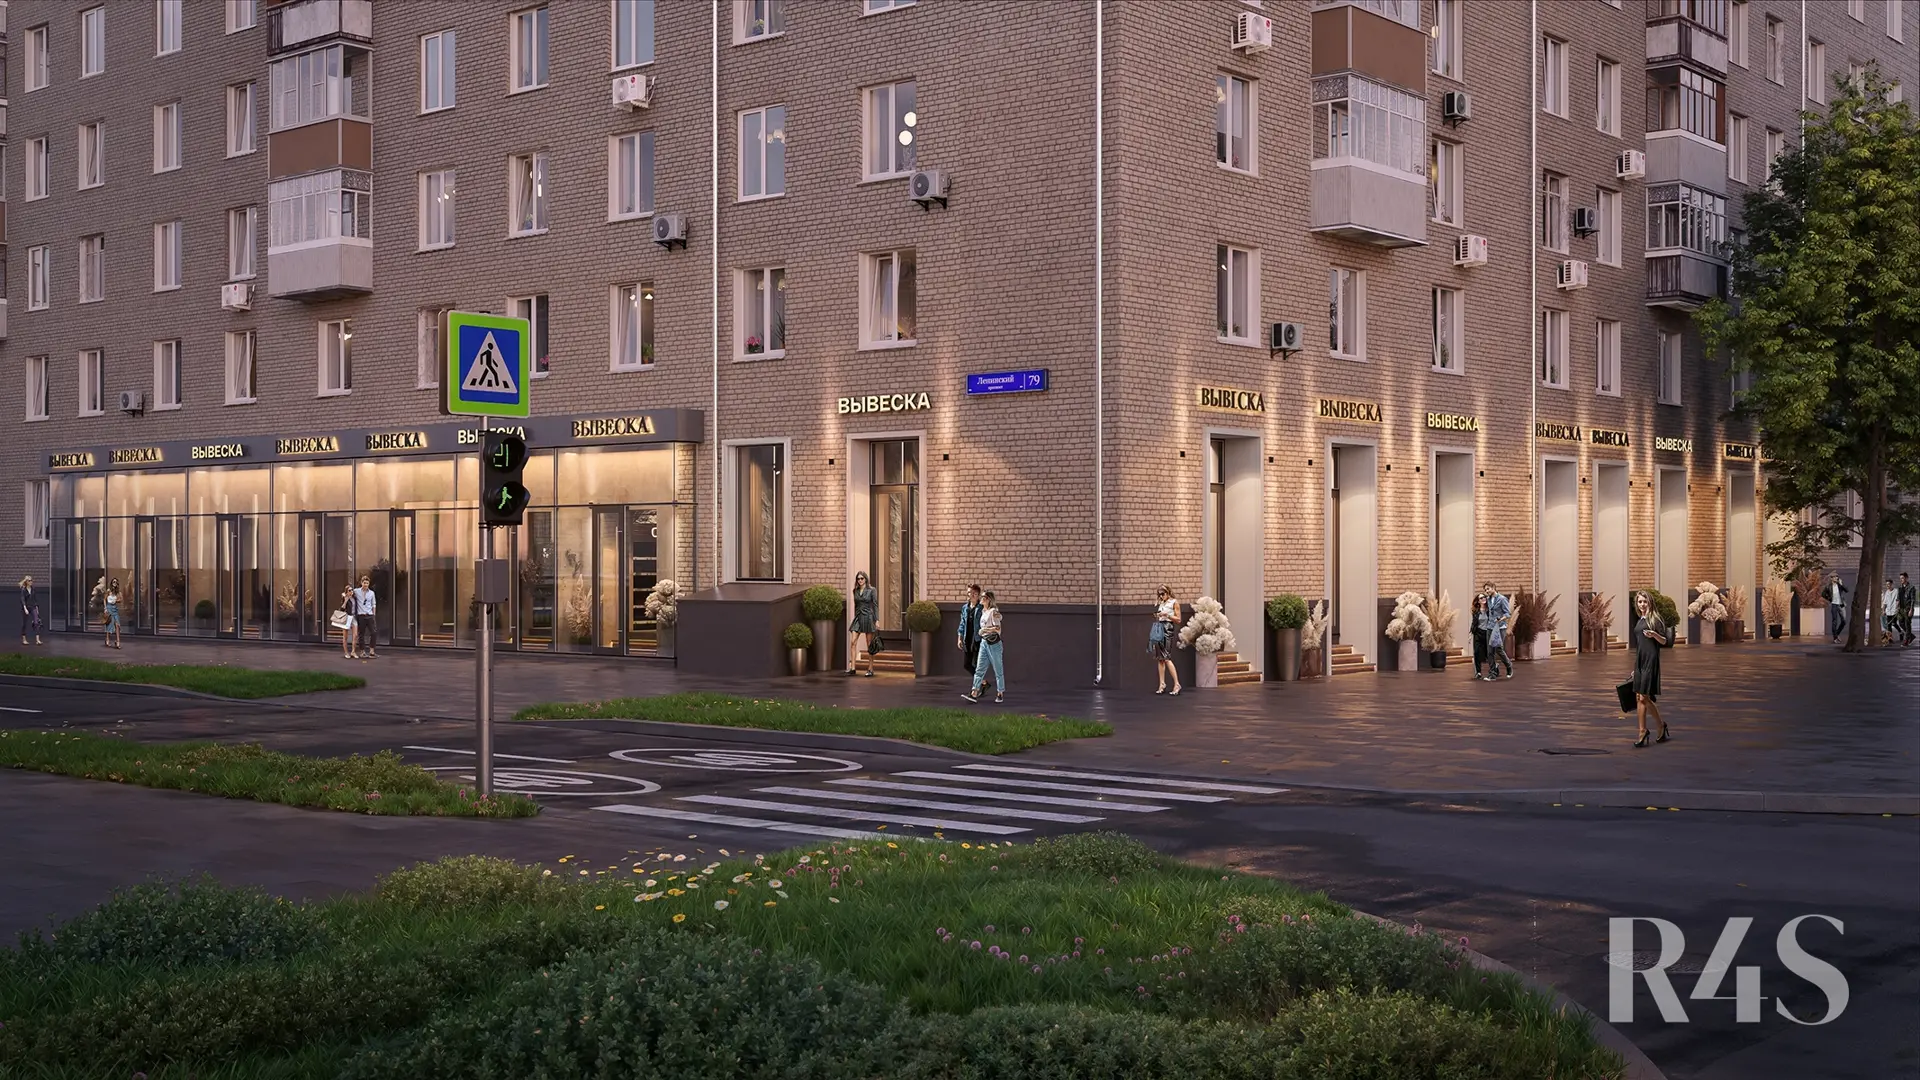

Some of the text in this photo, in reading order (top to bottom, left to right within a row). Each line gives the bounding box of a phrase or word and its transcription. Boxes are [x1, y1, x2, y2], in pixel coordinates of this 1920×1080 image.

[1028, 375, 1040, 386] 79
[838, 392, 931, 414] ВЫВЕСКА
[1201, 388, 1266, 412] ВЫВЕСКА
[572, 416, 649, 437] ВЫВЕСКА
[1427, 412, 1480, 431] ВЫВЕСКА
[366, 432, 421, 450] ВЫВЕСКА
[1535, 423, 1582, 441] ВЫВЕСКА
[1592, 429, 1629, 447] ВЫВЕСКА
[191, 444, 243, 459] ВЫВЕСКА
[275, 436, 334, 453] ВЫВЕСКА
[1655, 437, 1692, 452] ВЫВЕСКА
[49, 453, 88, 468] ВЫВЕСКА
[109, 447, 158, 463] ВЫВЕСКА
